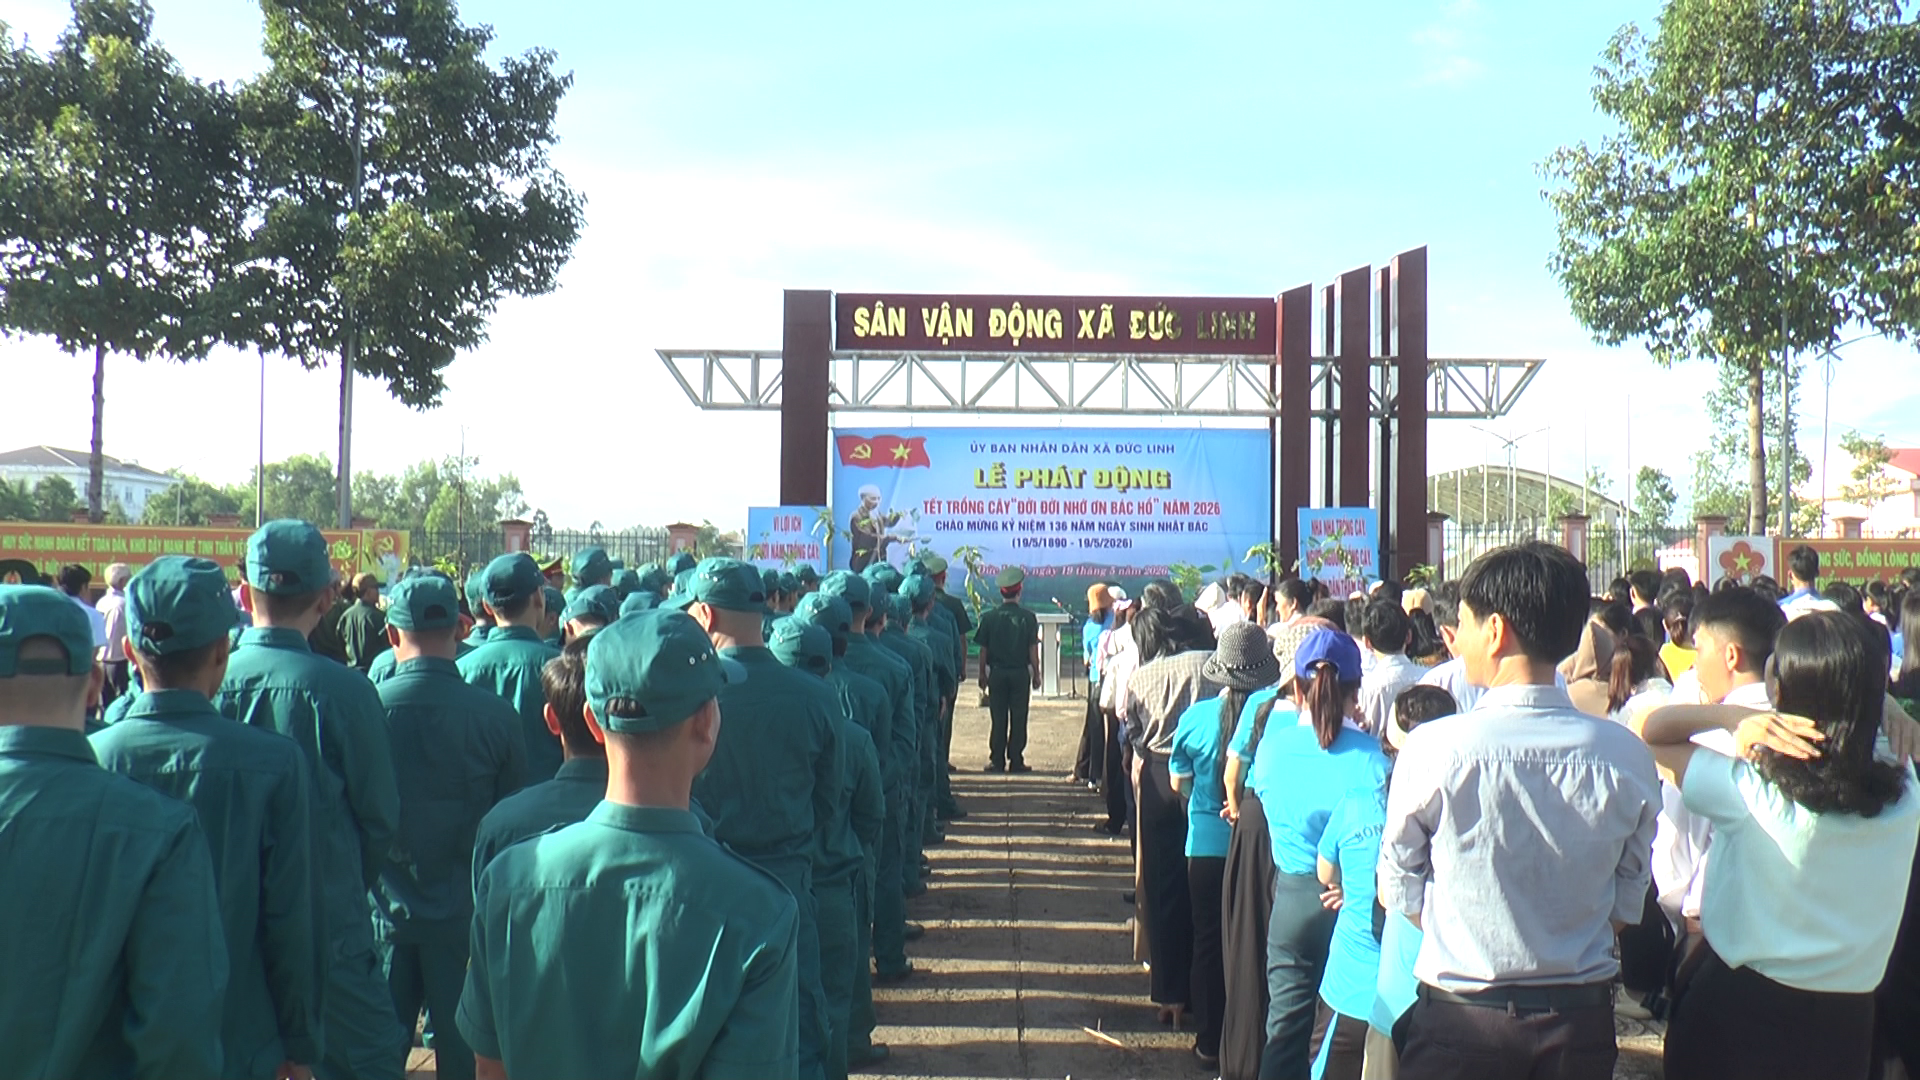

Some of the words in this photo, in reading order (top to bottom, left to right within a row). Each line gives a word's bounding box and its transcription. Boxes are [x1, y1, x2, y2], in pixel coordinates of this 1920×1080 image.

[854, 300, 906, 338] SÂN
[921, 301, 974, 345] VẬN
[988, 301, 1063, 347] ĐỘNG
[1077, 303, 1116, 339] XÃ
[1129, 301, 1182, 340] ĐỨC
[1197, 310, 1257, 340] LINH
[970, 440, 986, 454] ỦY
[990, 443, 1017, 454] BAN
[1020, 440, 1058, 454] NHÂN
[1061, 441, 1089, 454] DÂN
[1093, 441, 1111, 455] XÃ
[1115, 441, 1142, 455] ĐỨC
[1147, 443, 1175, 455] LINH
[973, 461, 1007, 489] LỄ
[1013, 464, 1087, 489] PHÁT
[1093, 464, 1172, 494] ĐỘNG
[923, 496, 943, 515] TẾT
[1040, 497, 1060, 515] ĐỜI
[1063, 498, 1088, 515] NHỚ
[1091, 500, 1107, 515] ƠN
[1110, 498, 1134, 515] BÁC
[1163, 498, 1190, 515] NĂM
[1193, 501, 1221, 515] 2026
[935, 518, 964, 531] CHÀO
[967, 518, 999, 531] MỪNG
[1001, 517, 1015, 531] KỶ
[1018, 519, 1046, 534] NIỆM
[1050, 520, 1068, 532] 136
[1070, 519, 1095, 532] NĂM
[1098, 519, 1126, 532] NGÀY
[1129, 521, 1155, 532] SINH
[1157, 519, 1185, 534] NHẬT
[1187, 519, 1209, 532] BÁC
[1012, 537, 1067, 549] (19/5/1890
[1078, 537, 1133, 549] 19/5/2026)
[1833, 548, 1854, 570] SỨC,
[1856, 546, 1882, 567] ĐỒNG
[1883, 548, 1909, 567] LÒNG
[1032, 564, 1058, 577] ngày
[1061, 565, 1074, 576] 19
[1076, 564, 1107, 578] tháng
[1118, 564, 1141, 576] năm
[1143, 564, 1168, 577] 2026
